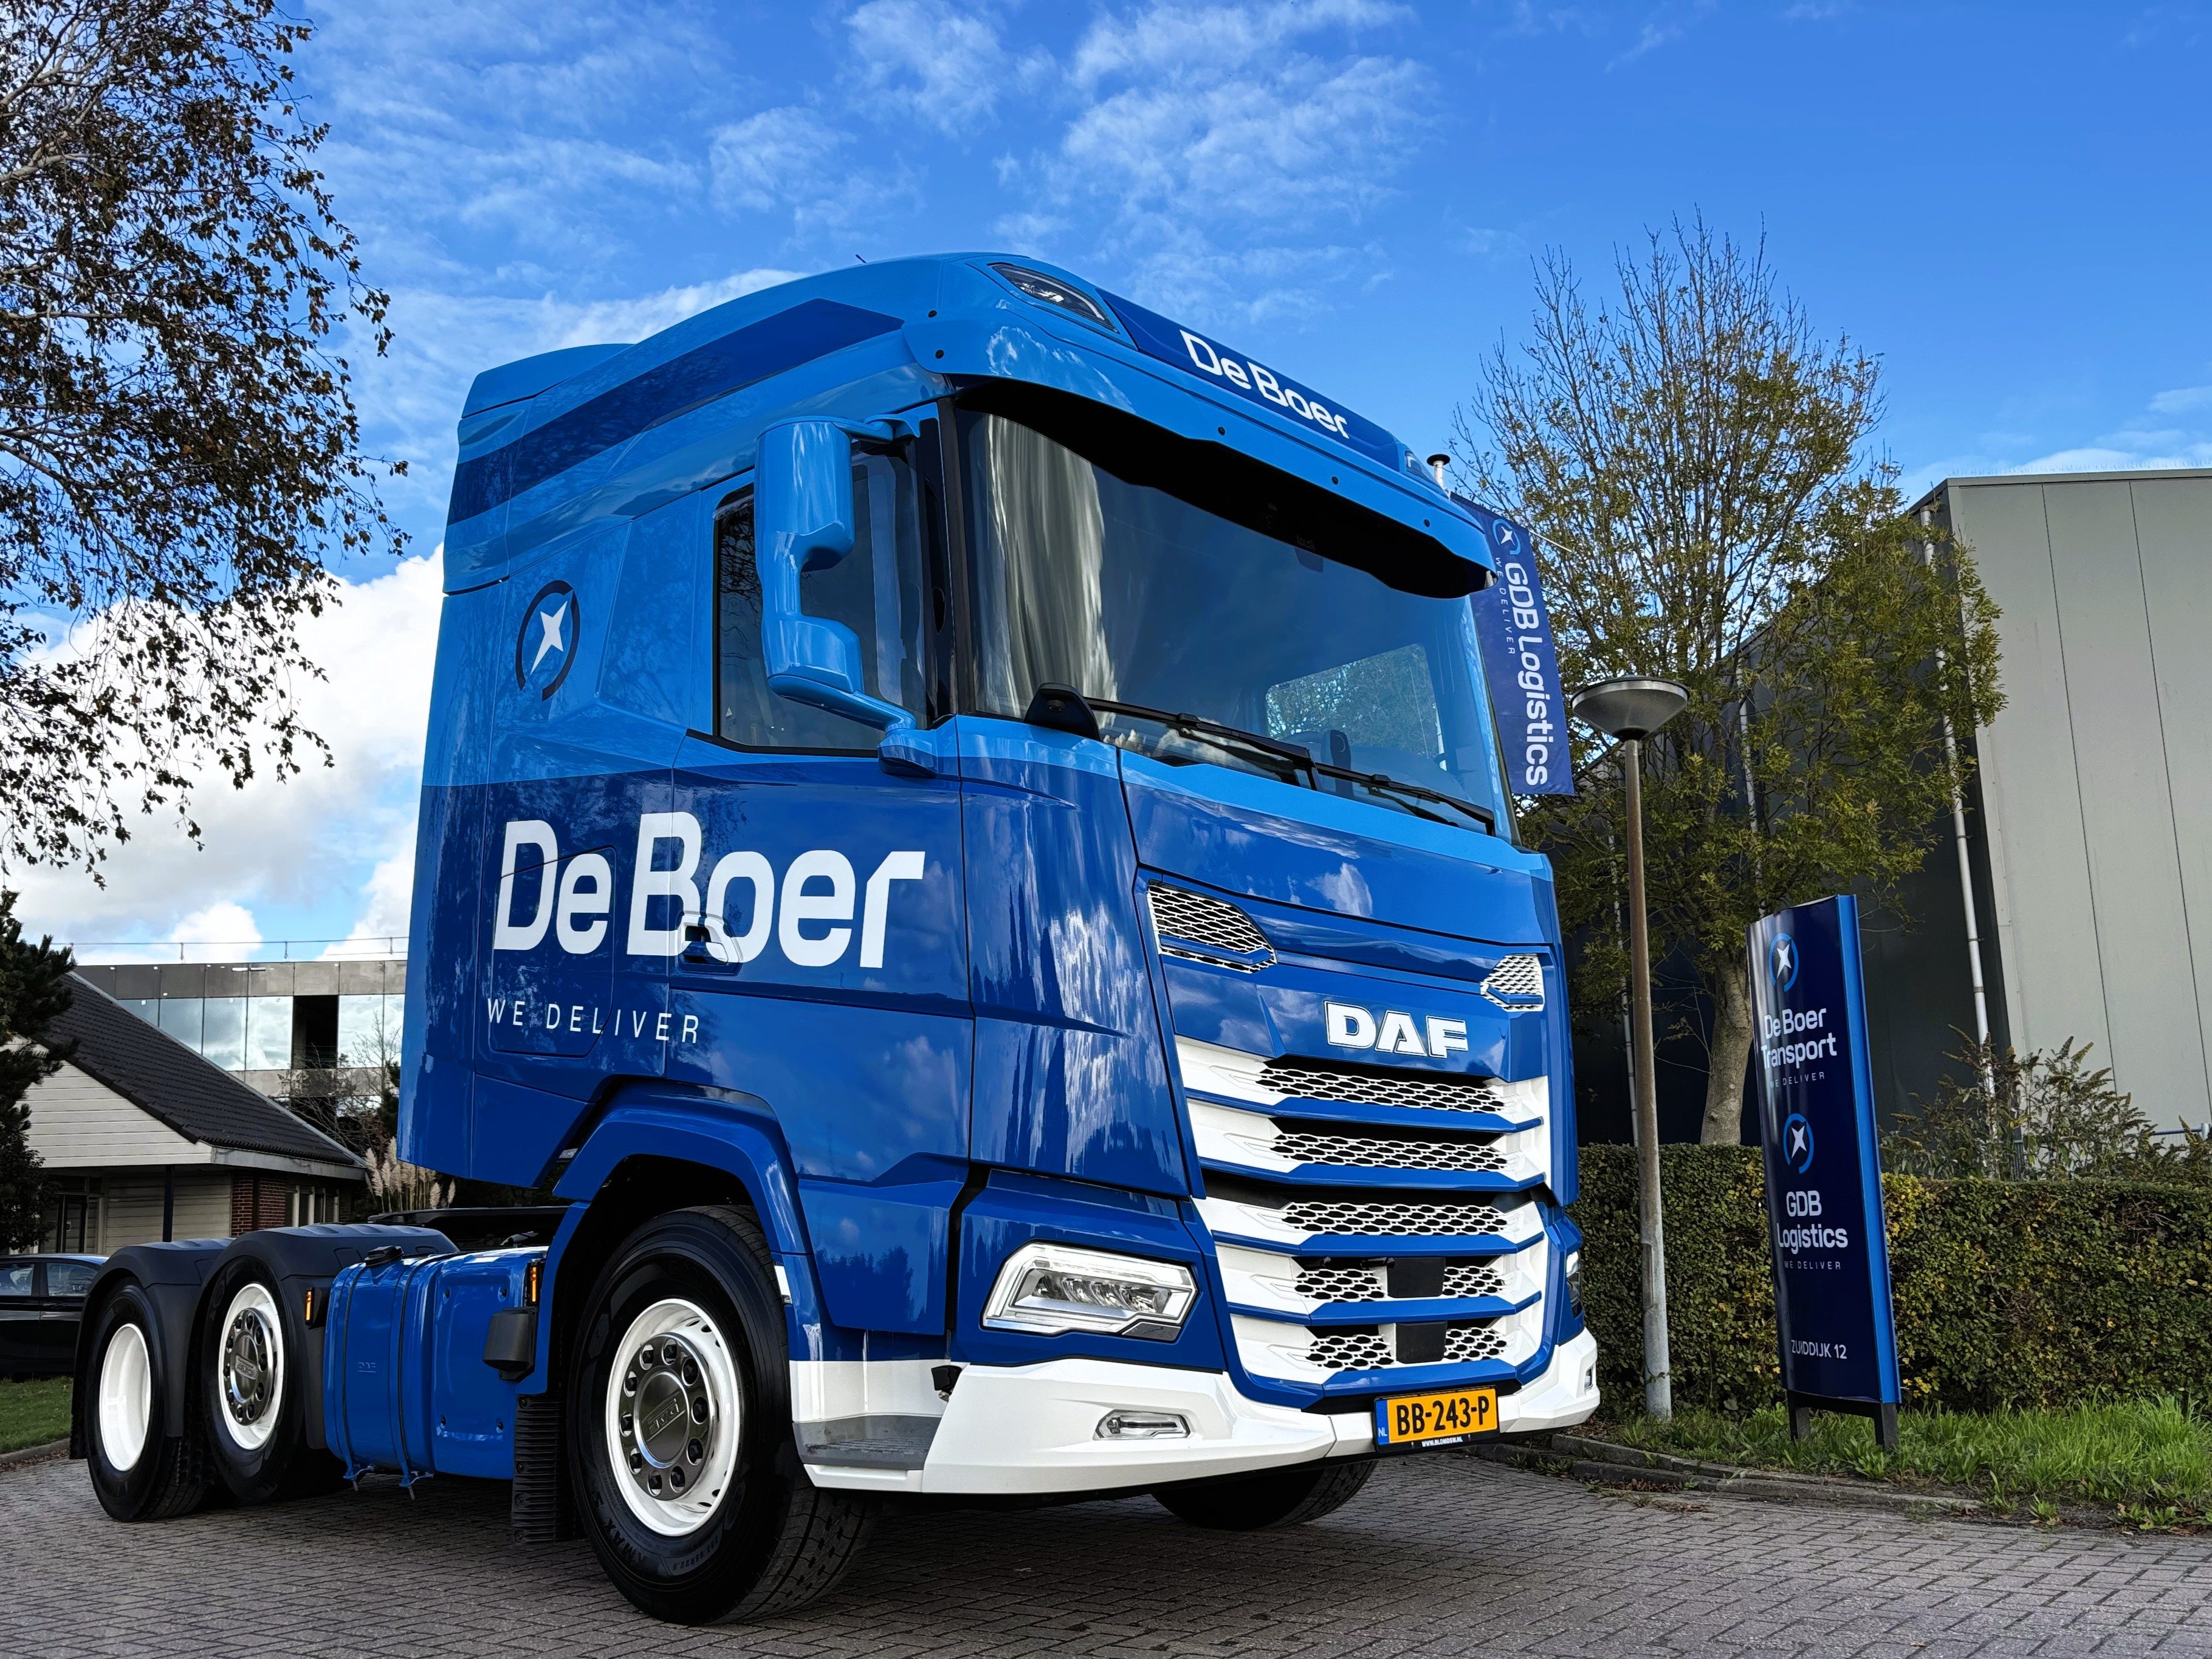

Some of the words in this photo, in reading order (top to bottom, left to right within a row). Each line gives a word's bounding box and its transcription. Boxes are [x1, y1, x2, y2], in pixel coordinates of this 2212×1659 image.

[1494, 557, 1503, 578] WE
[1505, 563, 1540, 630] GDB
[1498, 588, 1516, 655] DELIVER
[1517, 636, 1554, 786] Logistics
[493, 819, 610, 955] De
[627, 811, 926, 969] Boer
[487, 998, 524, 1026] WE
[546, 1005, 700, 1044] DELIVER
[1324, 1000, 1469, 1059] DAF
[1764, 1014, 1781, 1040] De
[1782, 1008, 1827, 1034] Boer
[1761, 1032, 1838, 1070] Transport
[1782, 1071, 1824, 1085] DELIVER
[1786, 1190, 1822, 1217] GDB
[1776, 1222, 1849, 1255] Logistics
[1784, 1260, 1794, 1269] WE
[1797, 1260, 1841, 1270] DELIVER
[1791, 1339, 1832, 1358] ZUIDDIJK
[1834, 1344, 1847, 1359] 12
[1378, 1427, 1388, 1438] NL
[1396, 1395, 1489, 1436] BB-243-P
